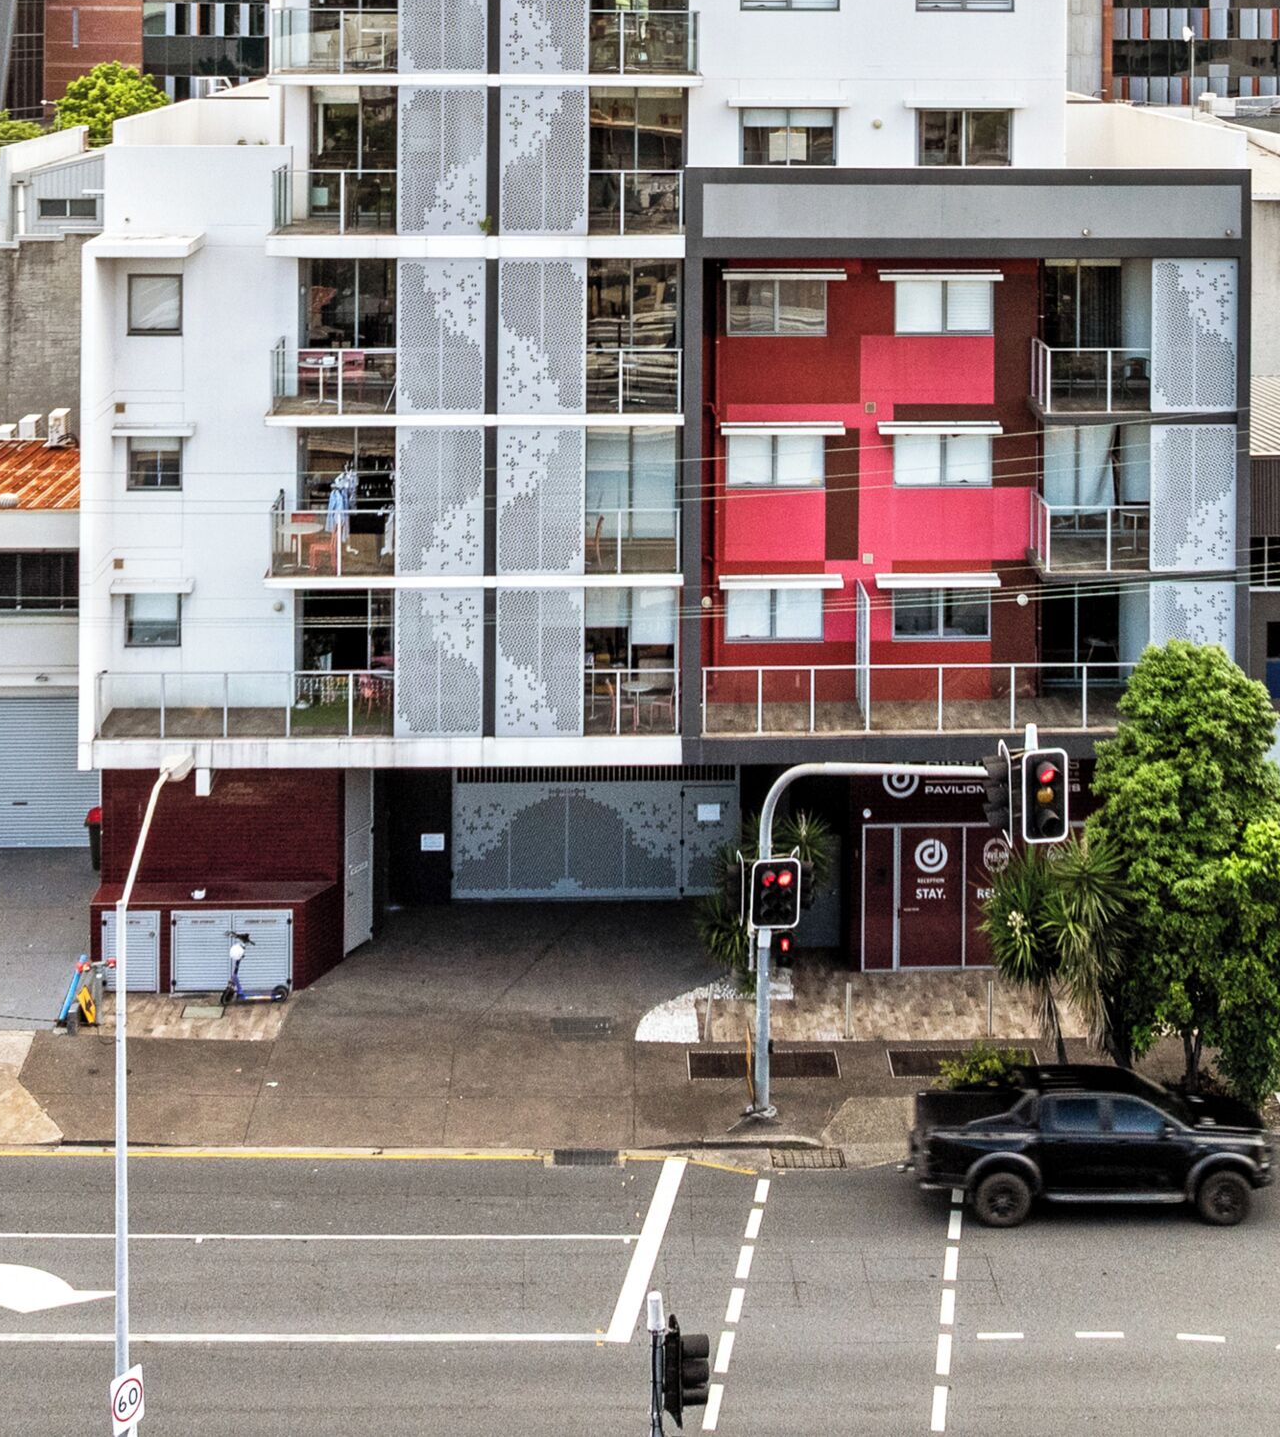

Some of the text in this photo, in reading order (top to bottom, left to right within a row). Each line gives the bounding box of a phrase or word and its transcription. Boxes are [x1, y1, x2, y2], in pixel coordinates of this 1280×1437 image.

[925, 785, 985, 795] PAVILION
[915, 888, 946, 899] STAY.
[118, 1387, 138, 1413] 60
